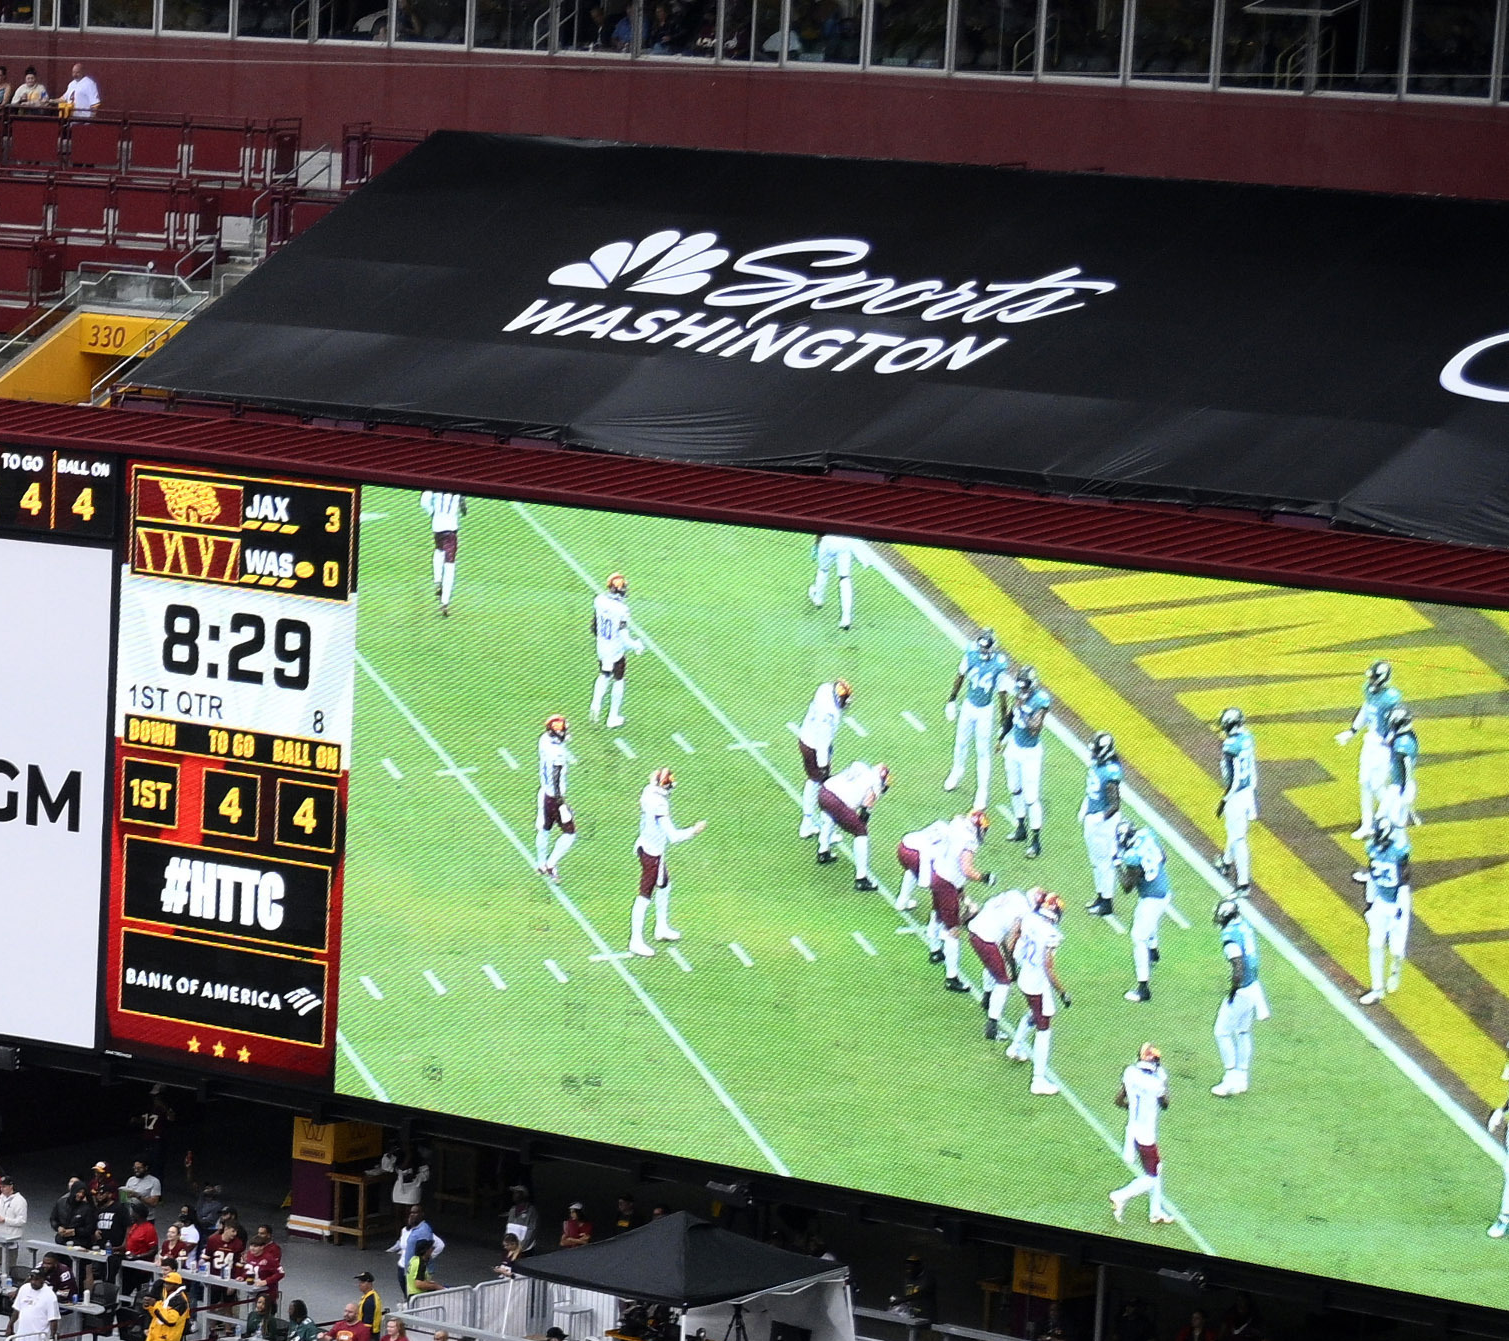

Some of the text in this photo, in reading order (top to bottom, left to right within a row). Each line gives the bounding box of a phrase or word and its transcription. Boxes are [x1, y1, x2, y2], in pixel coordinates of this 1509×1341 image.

[705, 239, 1115, 314] Sports
[88, 325, 126, 348] 330
[503, 296, 1009, 374] WASHINGTON
[2, 453, 44, 472] TO GO
[57, 459, 111, 479] BALL ON
[20, 483, 42, 514] 4
[72, 488, 95, 521] 4
[246, 494, 340, 534] JAX 3
[244, 549, 339, 589] WAS 0
[162, 604, 313, 690] 8:29
[129, 684, 325, 734] 1ST QTR 8
[129, 718, 177, 748] DOWN
[208, 728, 255, 758] TO GO
[273, 738, 339, 772] BALL ON
[130, 779, 172, 811] 1ST
[219, 787, 243, 825] 4
[292, 797, 317, 835] 4
[161, 857, 285, 931] #HTTC
[125, 967, 282, 1011] BANK OF AMERICA
